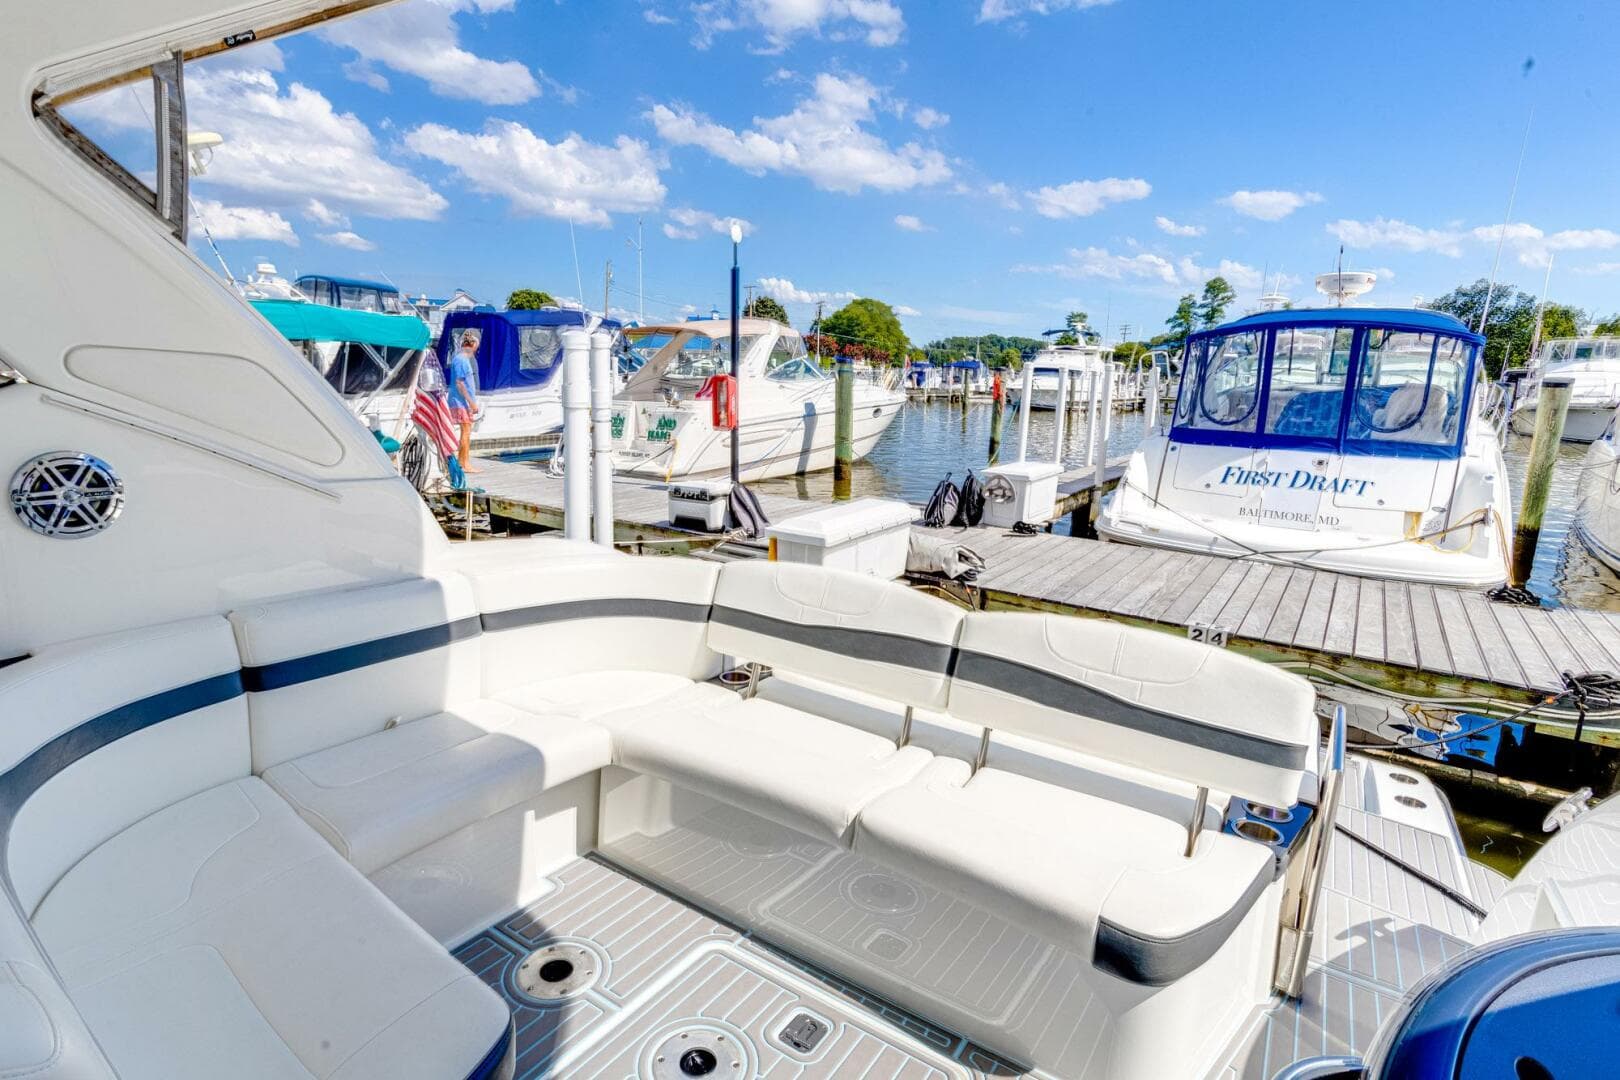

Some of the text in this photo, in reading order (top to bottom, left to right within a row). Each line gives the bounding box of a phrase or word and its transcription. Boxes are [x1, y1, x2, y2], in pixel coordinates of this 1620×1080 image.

[1219, 465, 1376, 497] FIRST DRAFT
[1238, 507, 1340, 526] BALTIMORE, MD
